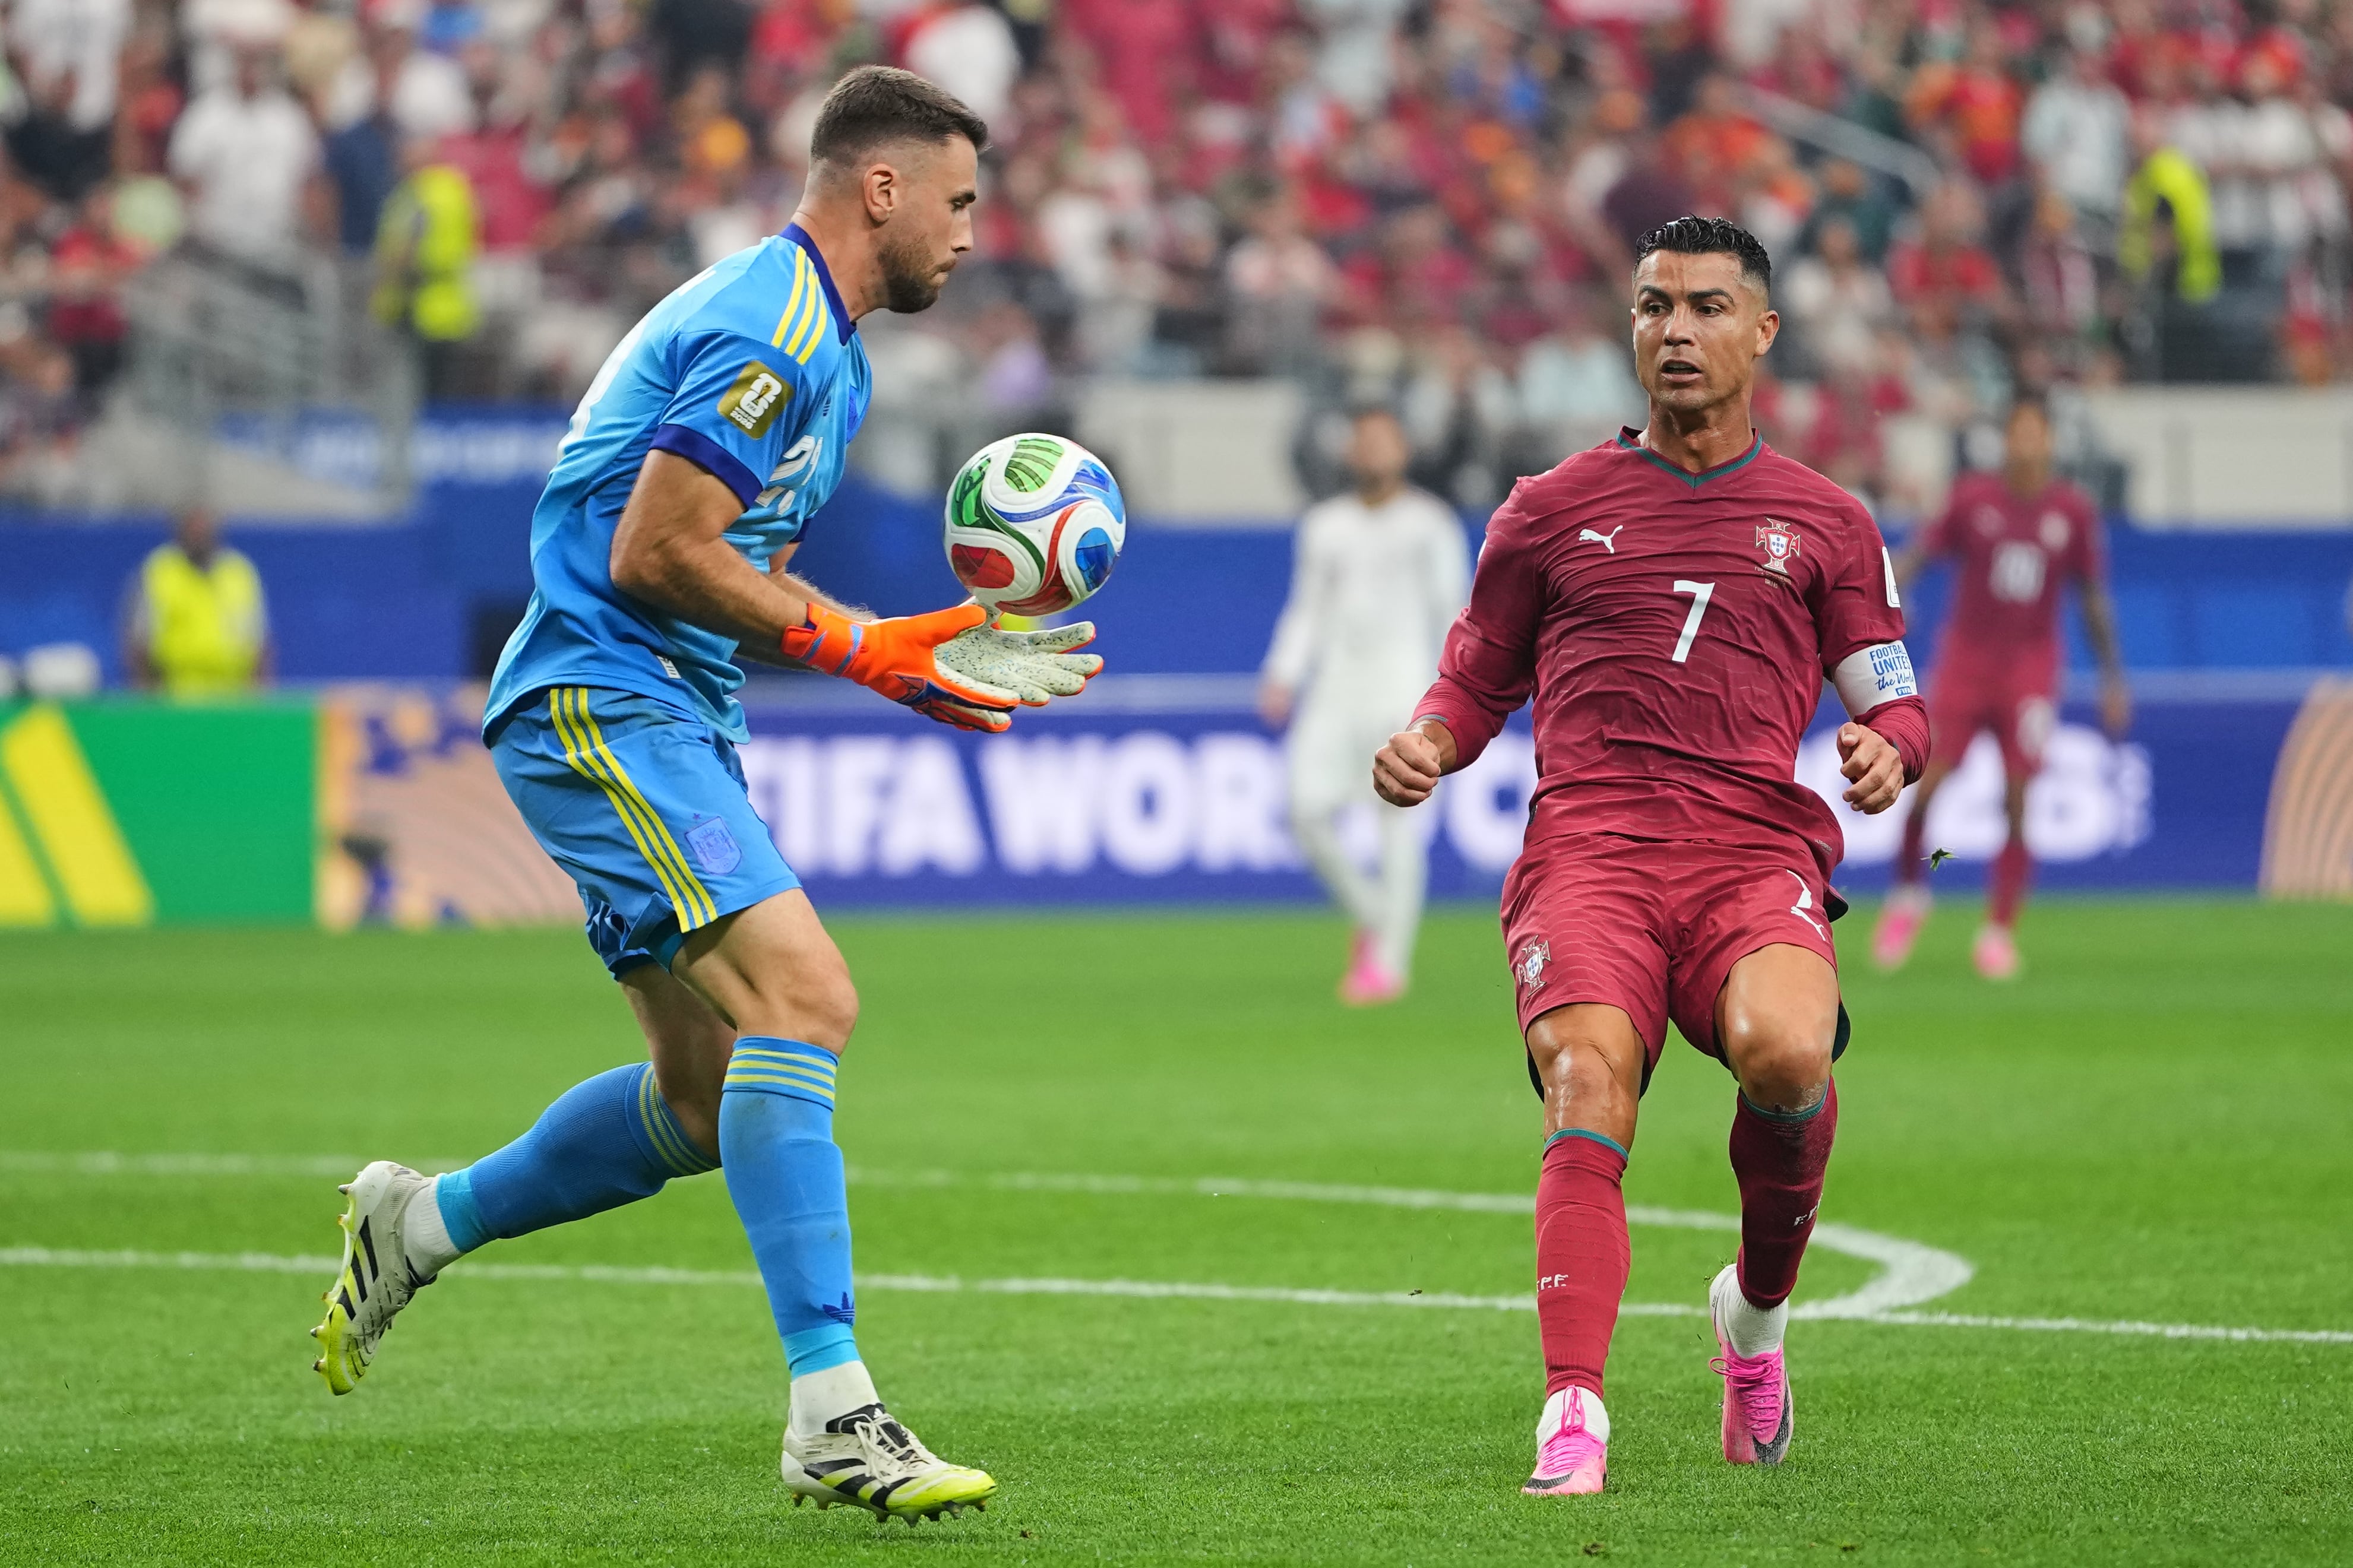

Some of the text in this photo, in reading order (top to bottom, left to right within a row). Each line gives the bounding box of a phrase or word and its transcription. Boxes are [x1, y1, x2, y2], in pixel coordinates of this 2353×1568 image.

[1671, 579, 1715, 663] 7
[1873, 655, 1911, 676] UNITES
[1875, 676, 1896, 690] the
